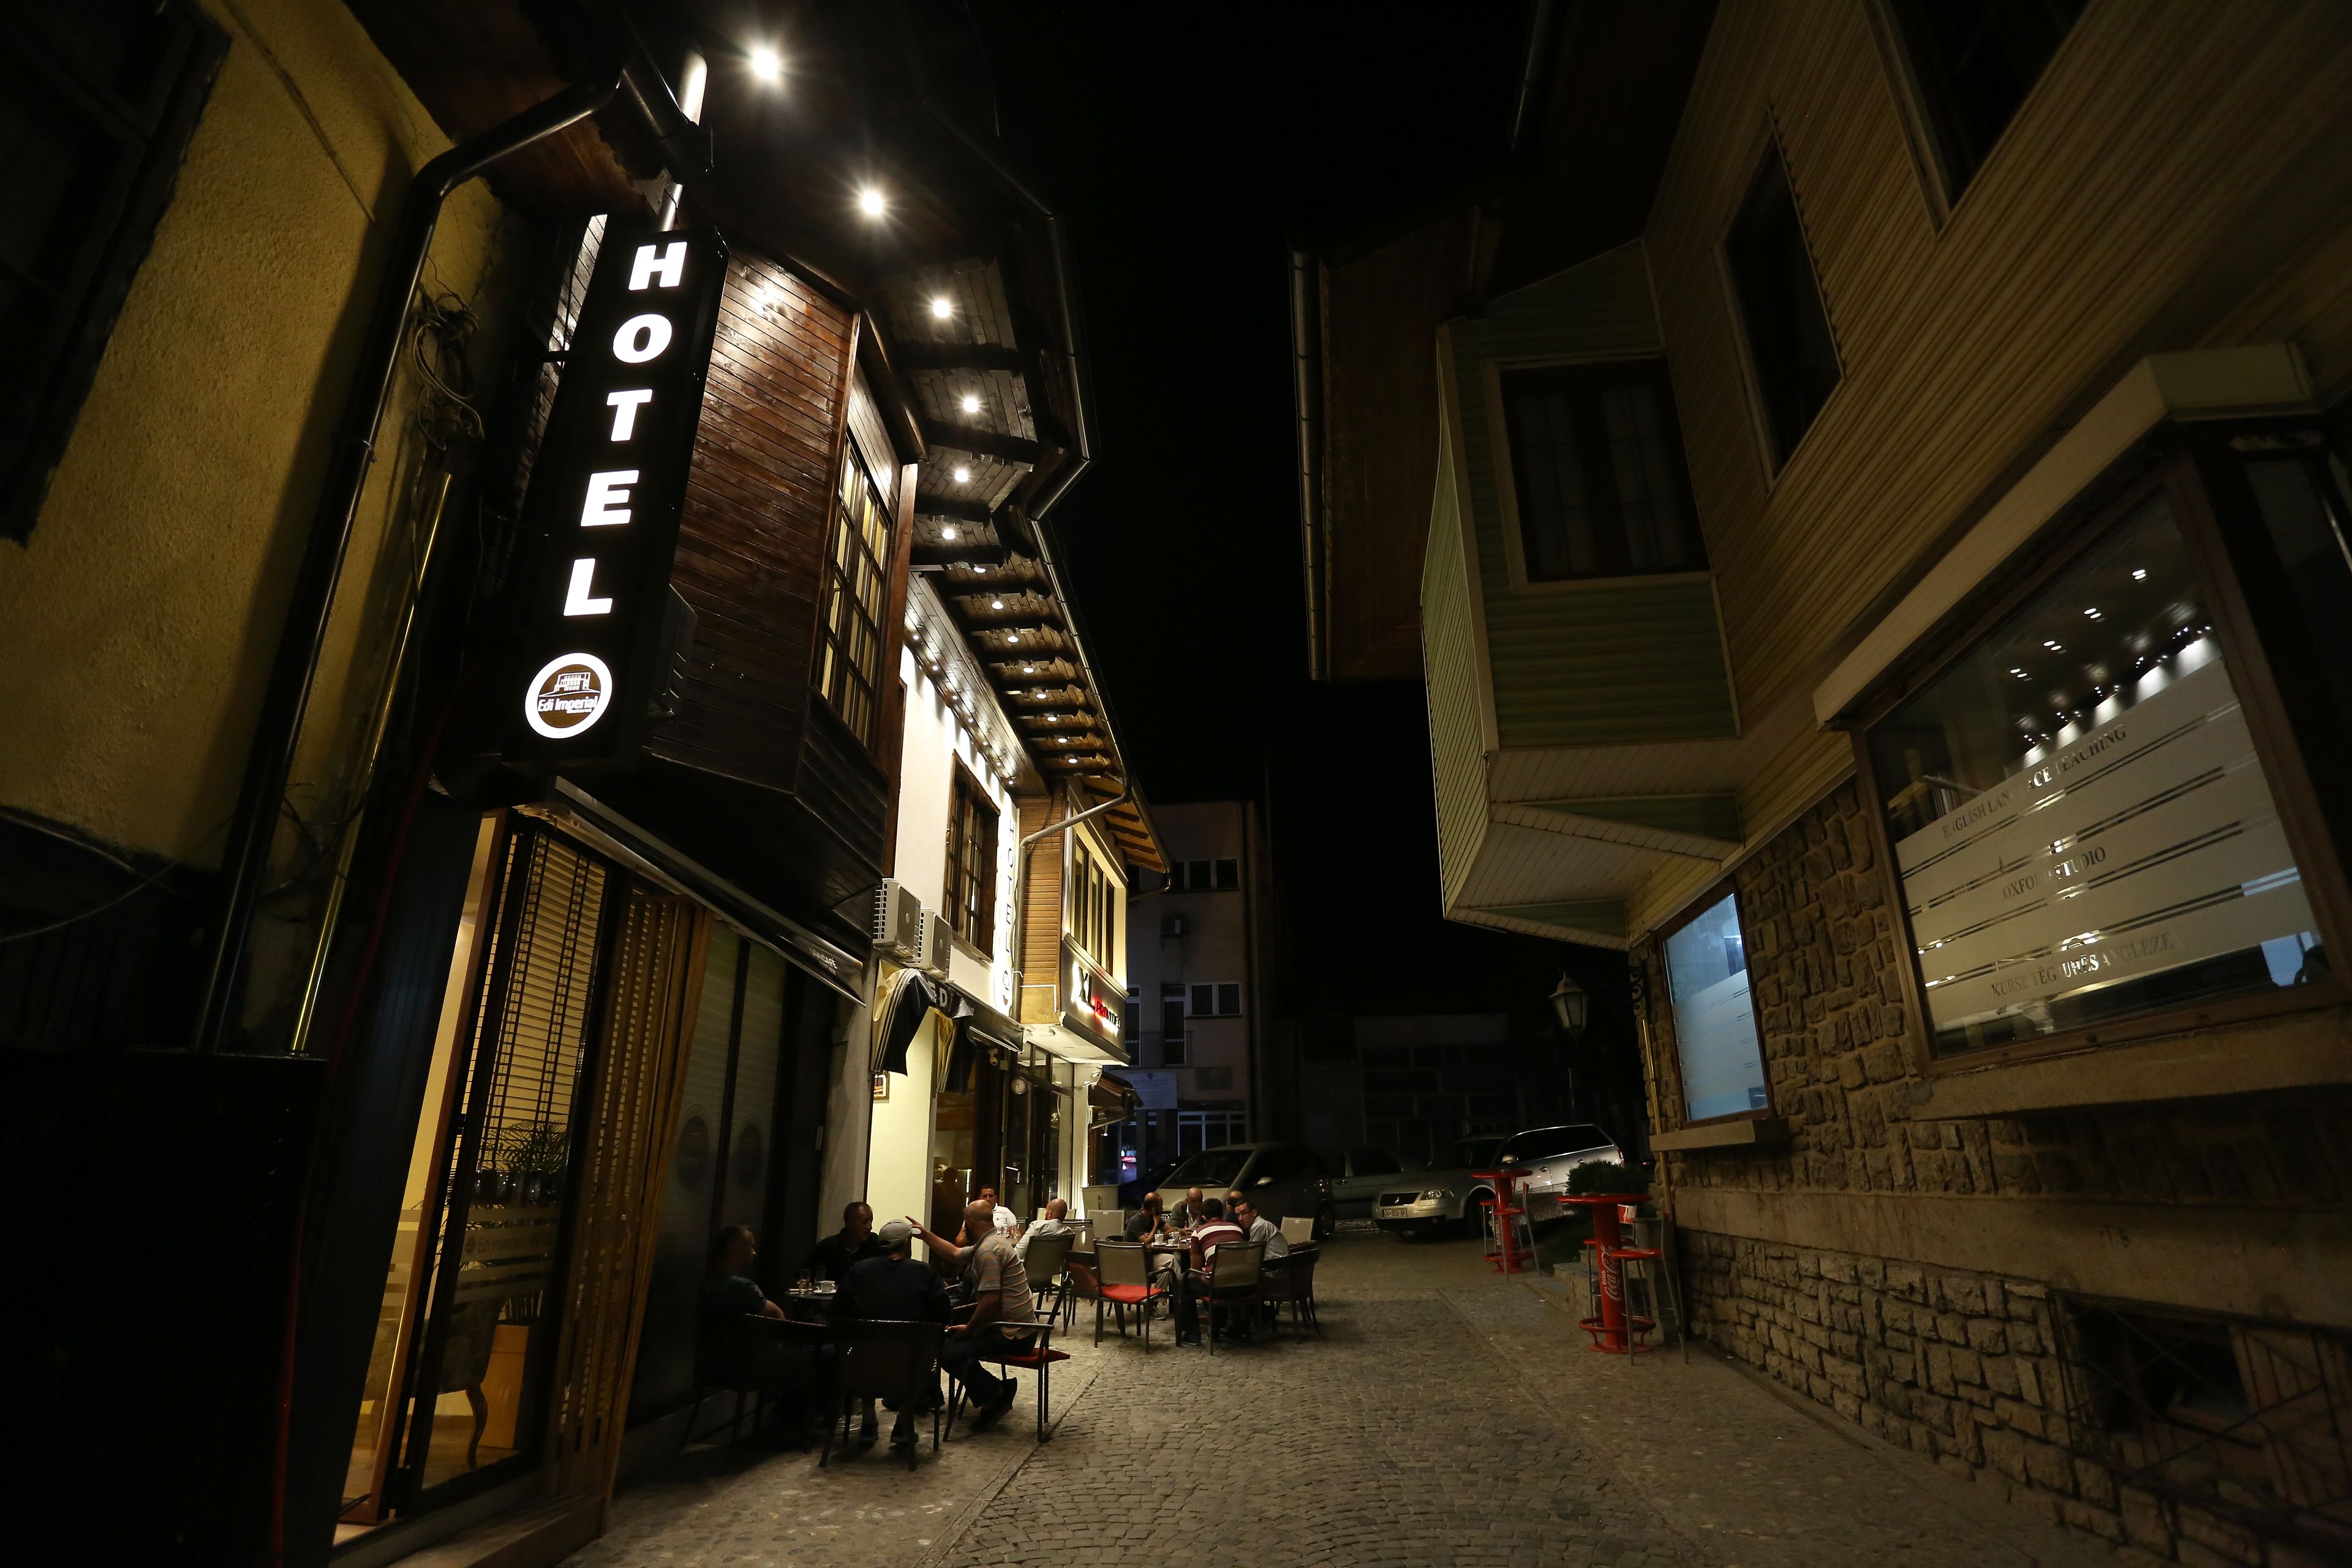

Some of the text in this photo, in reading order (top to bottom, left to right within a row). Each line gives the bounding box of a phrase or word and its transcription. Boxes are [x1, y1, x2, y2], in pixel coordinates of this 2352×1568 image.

[563, 241, 688, 617] HOTEL
[538, 695, 598, 712] Edi Imperial
[1942, 723, 2127, 839] ENGLISH LANAGE TEACHING
[2054, 846, 2106, 881] STUDIO
